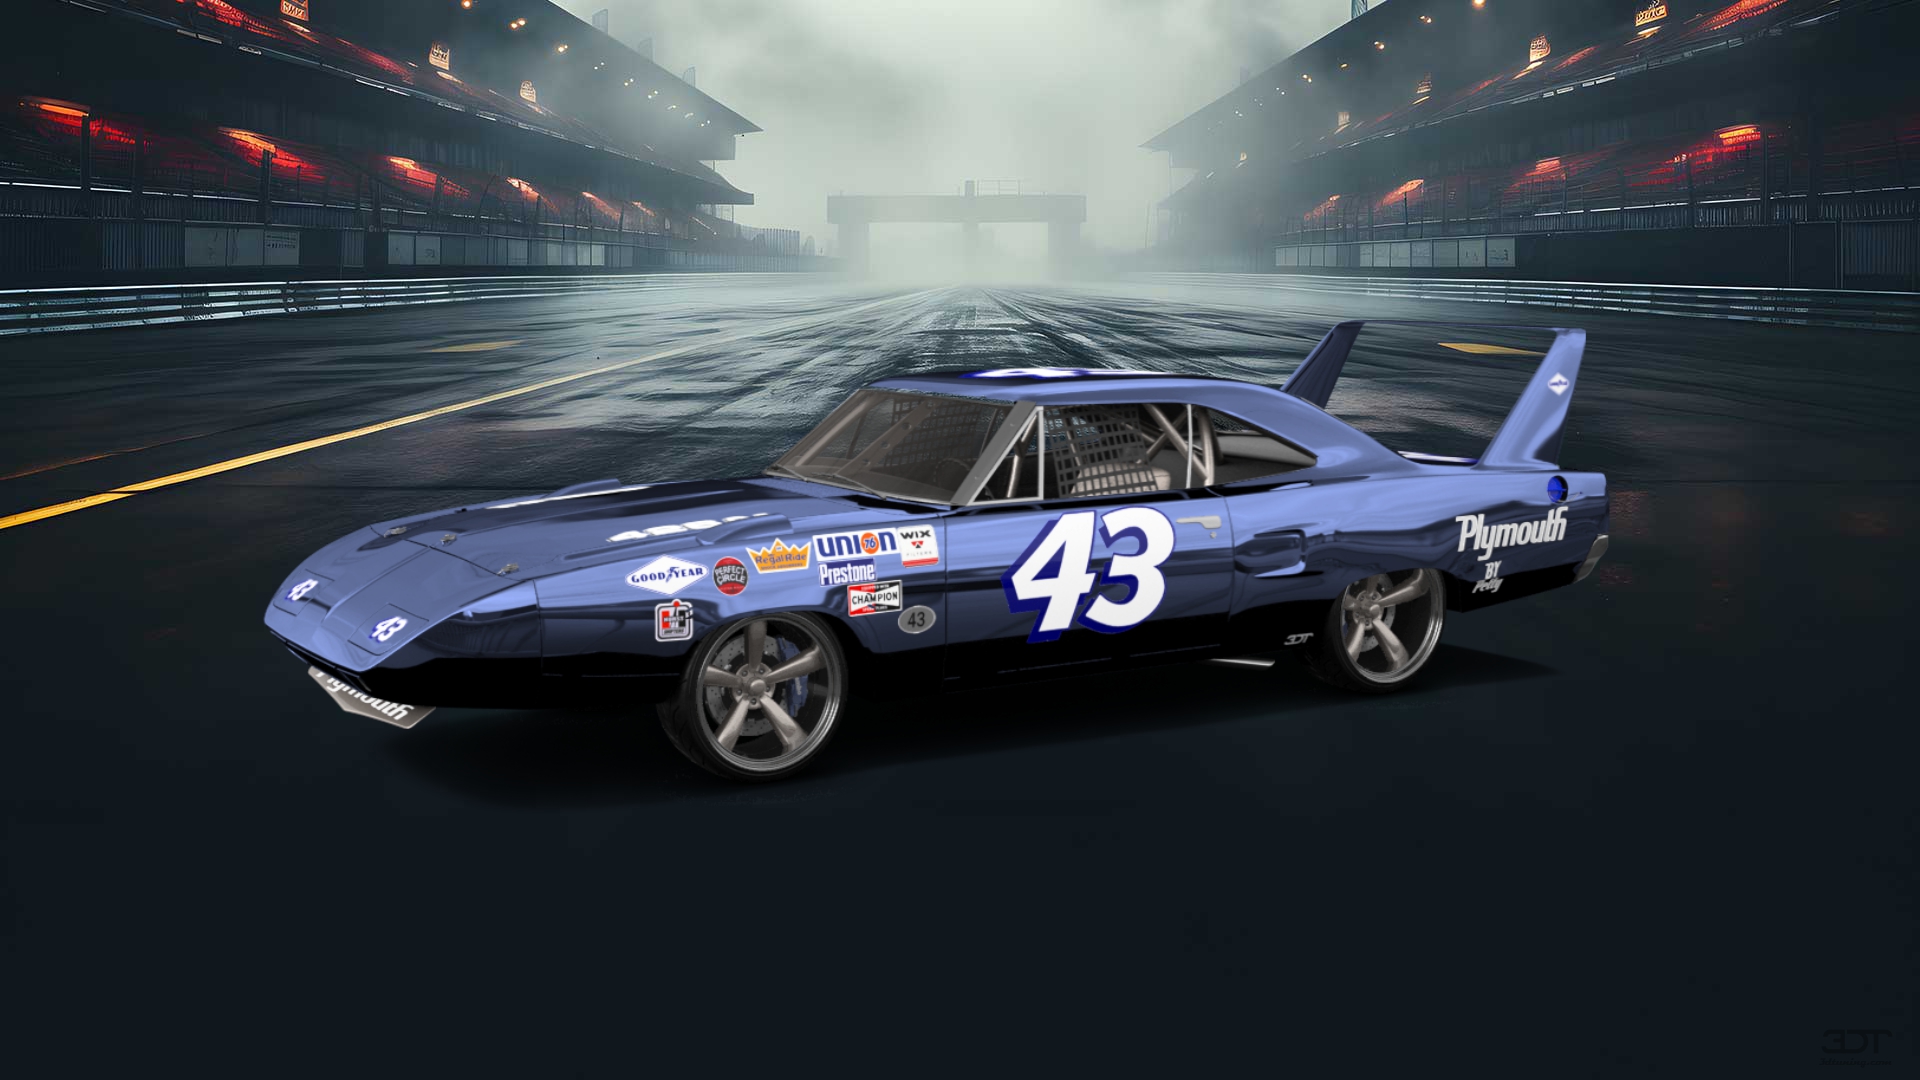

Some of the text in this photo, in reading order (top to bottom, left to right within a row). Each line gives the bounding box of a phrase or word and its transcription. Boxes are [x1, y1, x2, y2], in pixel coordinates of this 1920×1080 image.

[900, 530, 931, 539] WIX
[1456, 506, 1568, 561] Plymouth
[863, 537, 876, 549] 76
[755, 552, 806, 565] Regal Ride
[631, 566, 704, 584] GOODYEAR
[714, 565, 745, 575] PERFECT
[819, 562, 876, 587] Prestone
[1001, 505, 1176, 643] 43
[1485, 561, 1502, 580] BY
[716, 573, 746, 586] CIRCLE
[1472, 578, 1504, 593] Petty
[285, 578, 318, 602] 43
[852, 592, 898, 605] CHAMPION
[907, 612, 926, 628] 43
[369, 616, 408, 642] 43
[1284, 632, 1314, 645] 3DT
